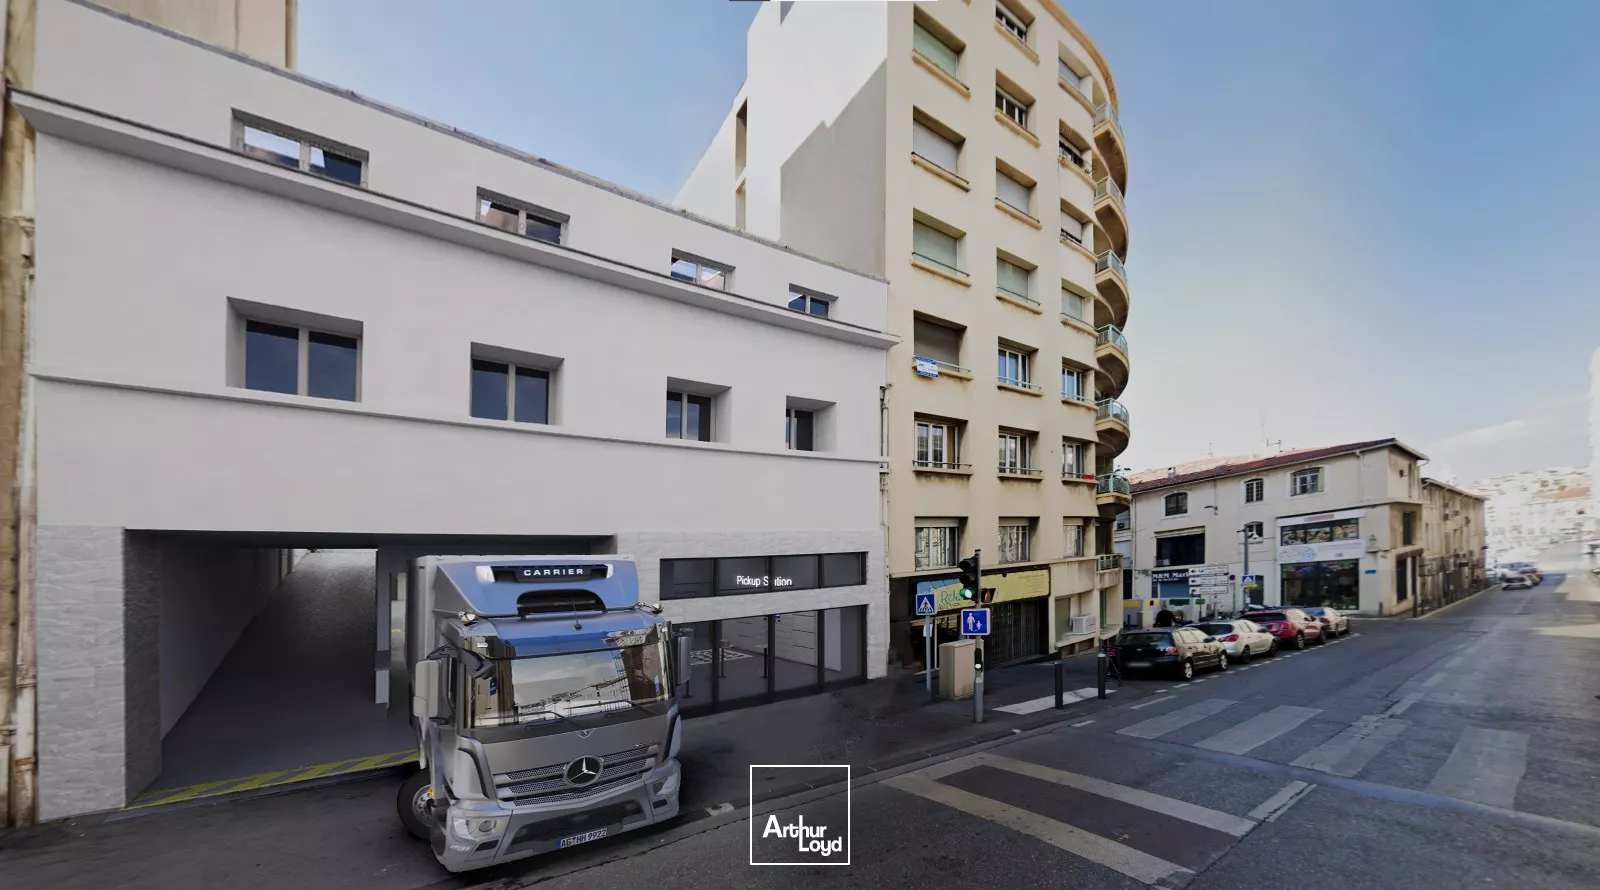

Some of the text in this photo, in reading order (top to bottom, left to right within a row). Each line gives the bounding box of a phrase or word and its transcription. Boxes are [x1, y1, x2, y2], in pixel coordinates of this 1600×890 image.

[523, 568, 584, 577] CARRIER
[736, 575, 793, 588] Pickup Stion
[587, 829, 606, 841] 9922
